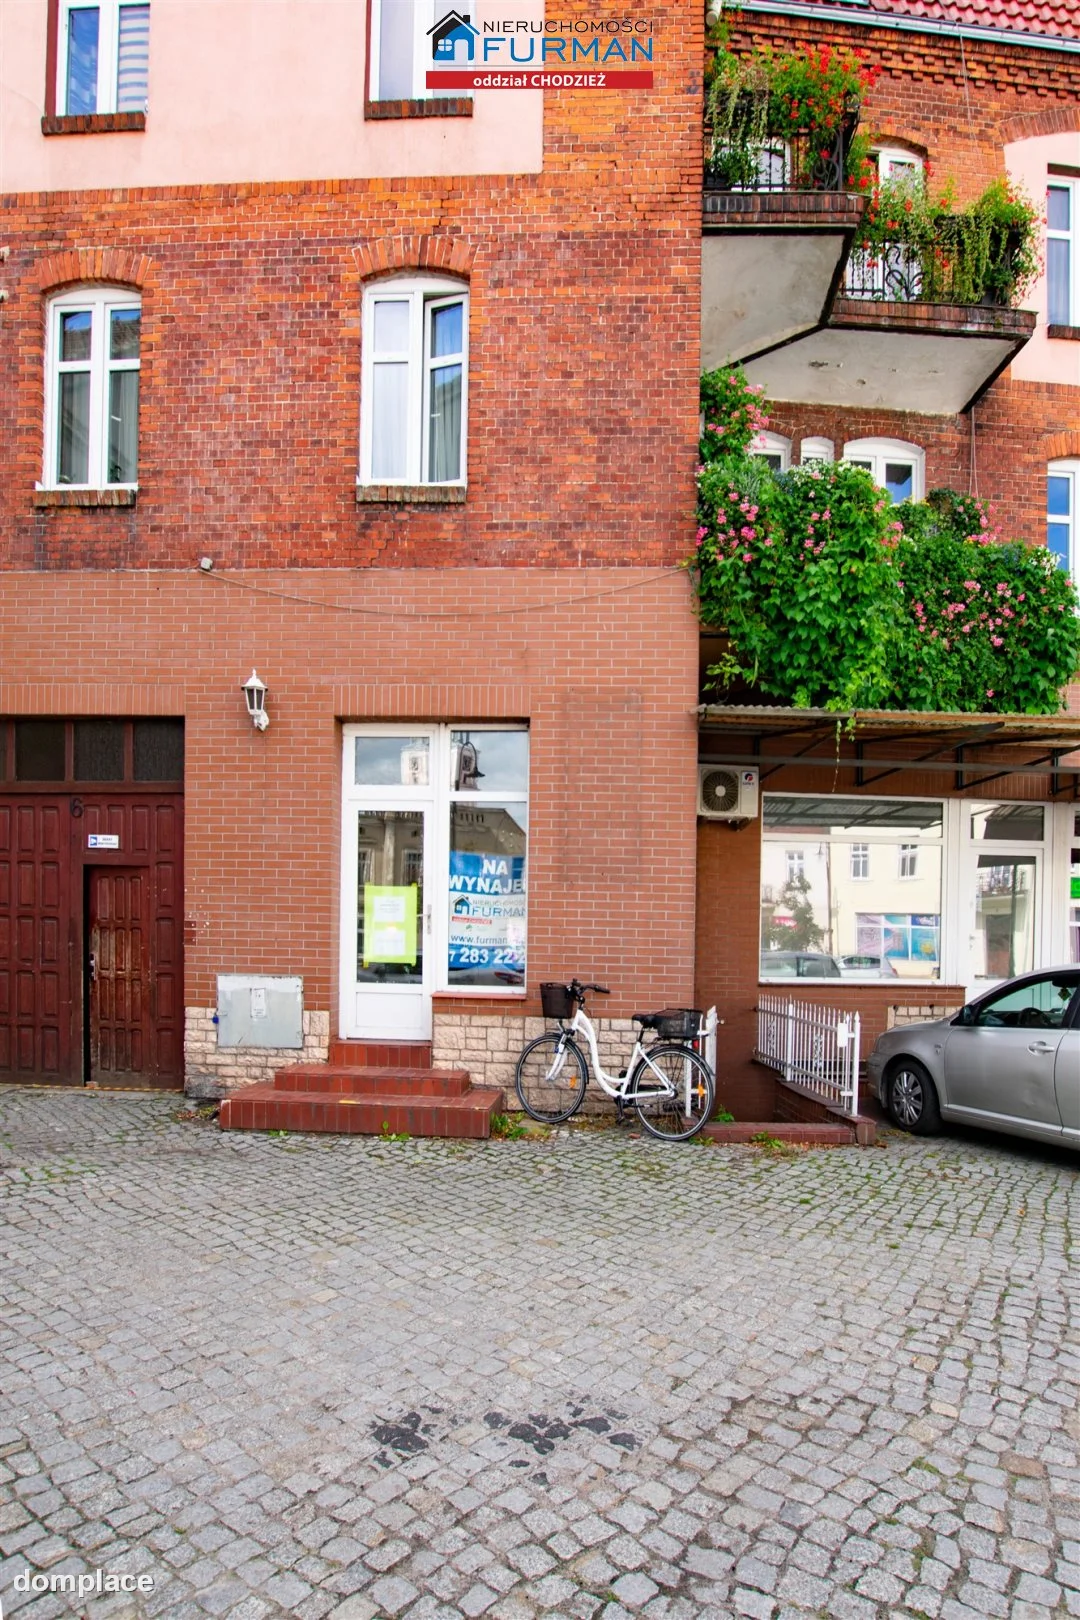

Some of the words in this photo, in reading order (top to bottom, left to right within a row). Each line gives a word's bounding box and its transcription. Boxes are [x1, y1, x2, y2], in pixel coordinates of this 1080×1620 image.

[72, 798, 83, 817] 6
[482, 859, 508, 875] NA
[449, 875, 526, 893] WYNAJE
[459, 948, 489, 963] 283
